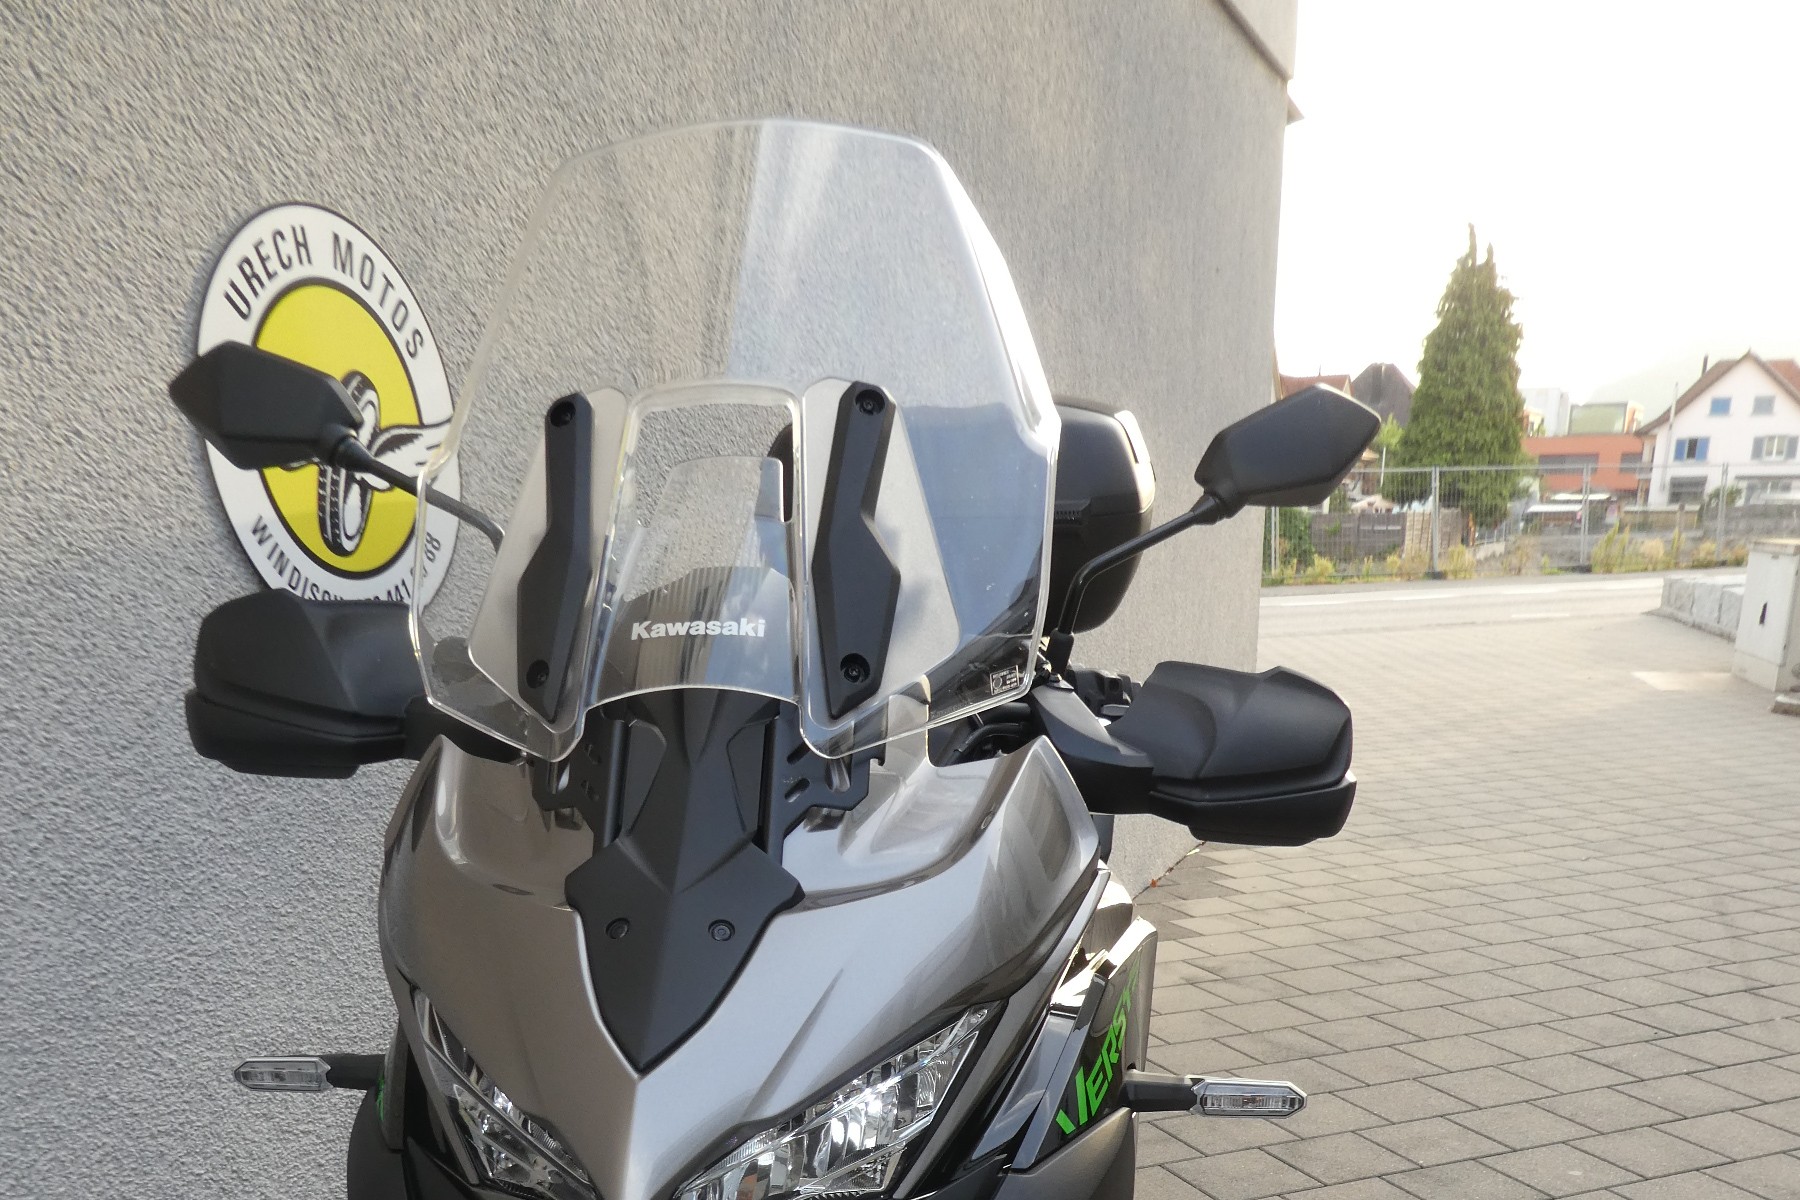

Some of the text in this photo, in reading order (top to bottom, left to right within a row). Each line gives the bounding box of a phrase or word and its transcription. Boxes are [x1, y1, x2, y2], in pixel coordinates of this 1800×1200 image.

[223, 224, 425, 360] URECH MOTOS
[250, 514, 344, 601] WINDIS
[631, 617, 766, 641] Kawasaki
